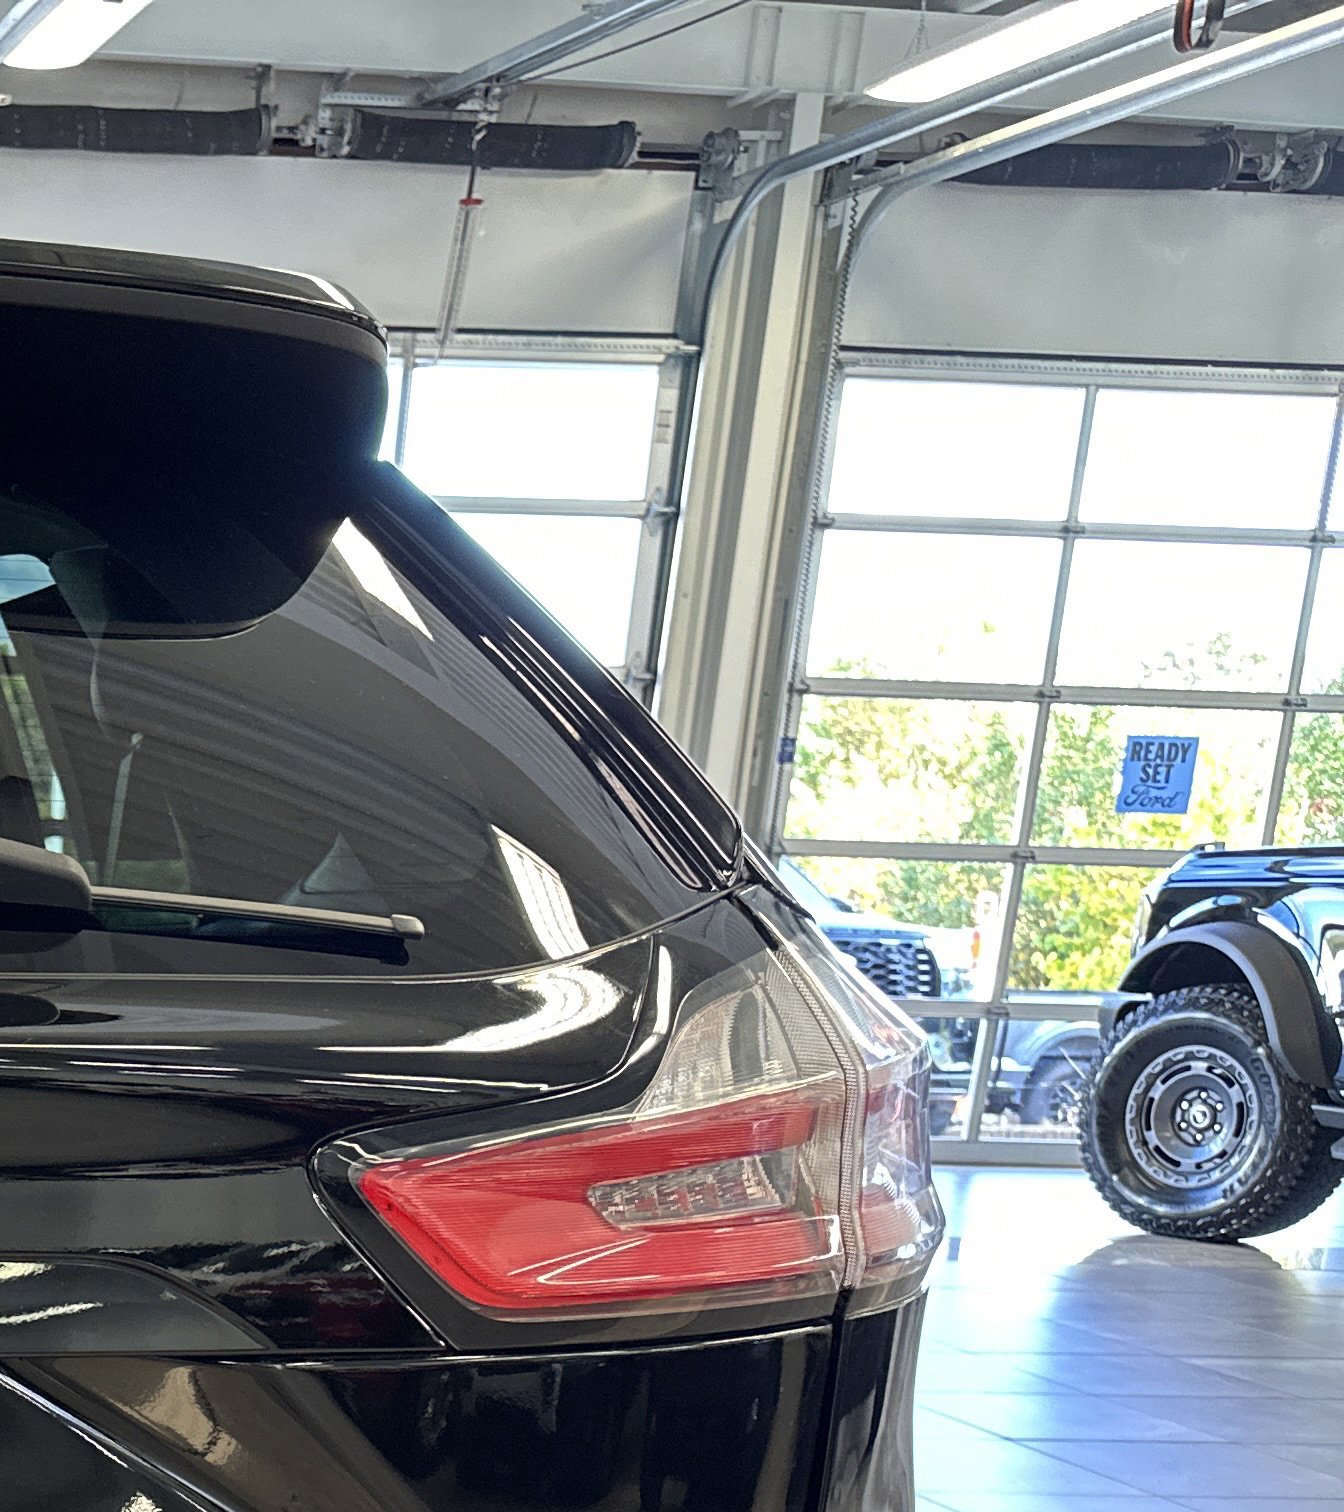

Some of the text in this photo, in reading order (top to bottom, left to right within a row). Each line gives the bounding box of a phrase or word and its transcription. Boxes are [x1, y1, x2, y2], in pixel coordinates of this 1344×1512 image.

[1130, 741, 1192, 763] READY
[1139, 763, 1174, 784] SET
[1123, 783, 1185, 809] Ford
